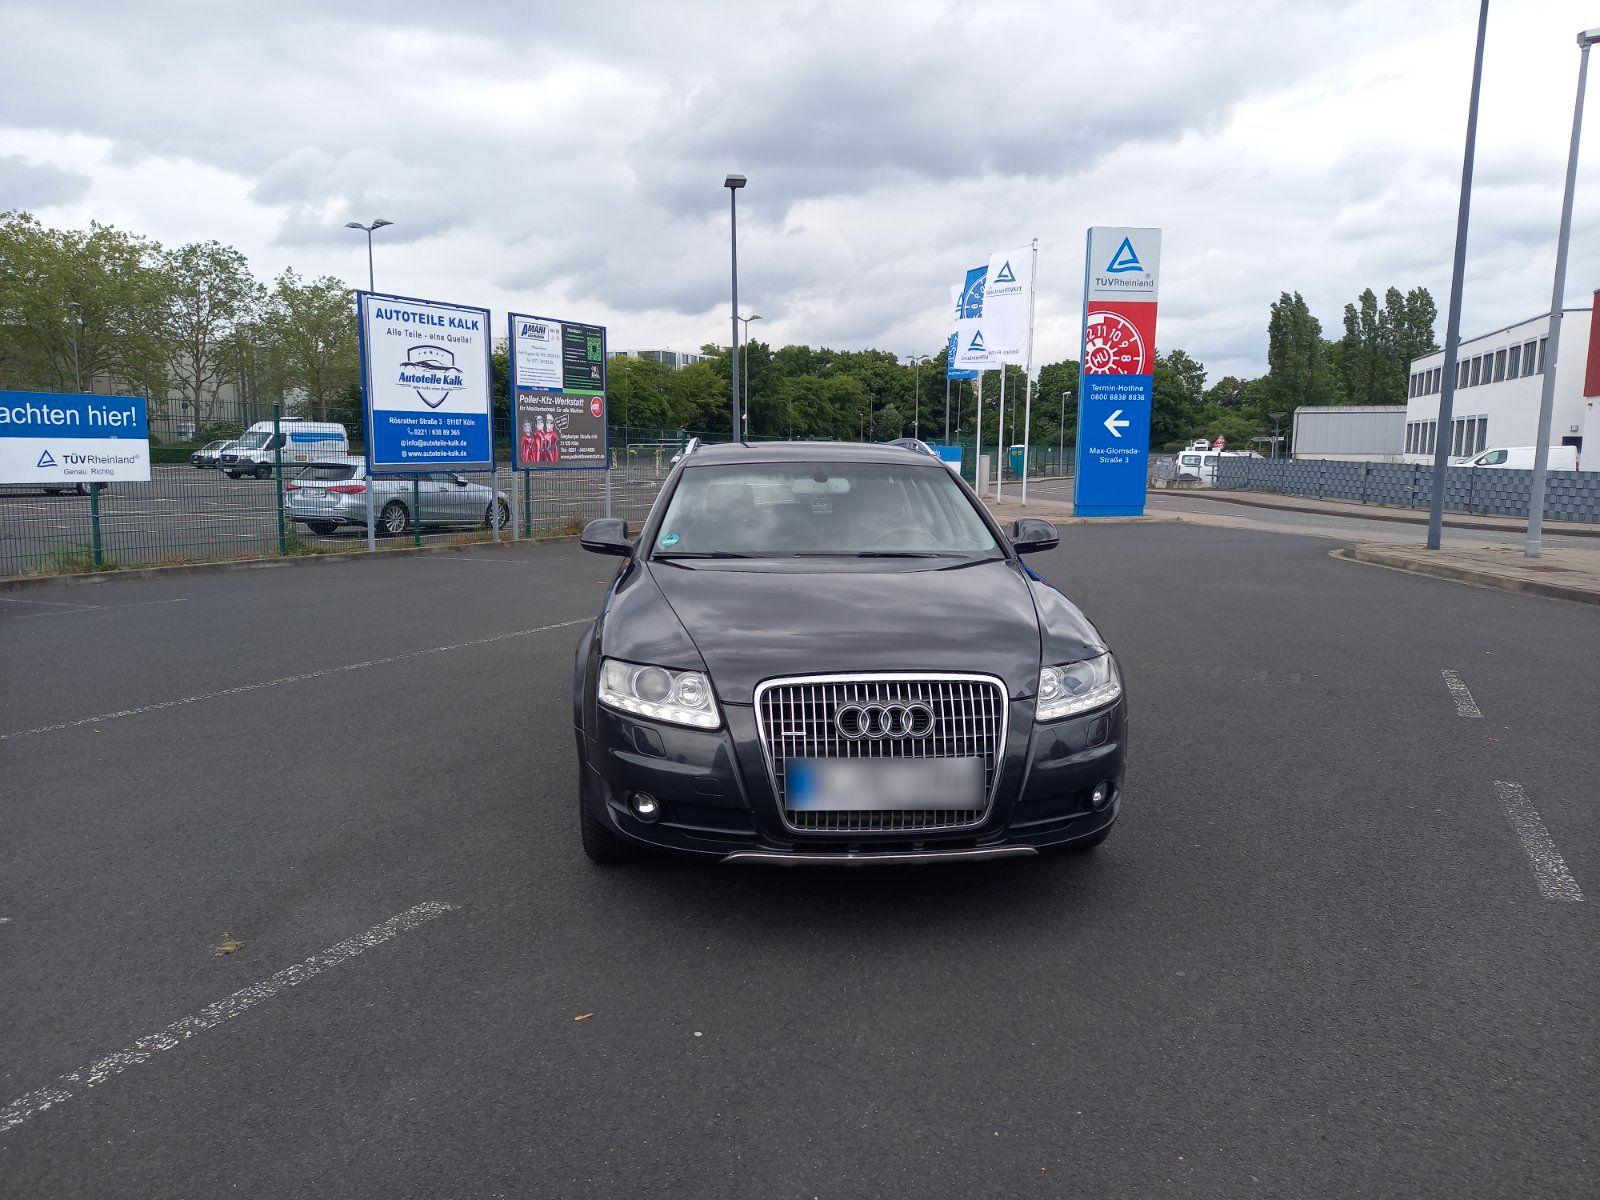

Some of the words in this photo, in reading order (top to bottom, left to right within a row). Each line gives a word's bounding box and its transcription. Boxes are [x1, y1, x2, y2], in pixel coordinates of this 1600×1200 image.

[376, 308, 444, 326] AUTOTEILE
[449, 317, 480, 331] KALK
[386, 328, 401, 336] Alle
[405, 330, 422, 338] Teile
[429, 332, 445, 341] eine
[446, 334, 472, 344] Quelle!
[1097, 325, 1107, 336] 11
[1109, 328, 1122, 342] 10
[1092, 349, 1108, 366] HU
[398, 372, 442, 385] Autoteile
[443, 375, 463, 386] Kalk
[519, 395, 584, 406] Poller-Kfz-Werkstatt
[88, 404, 137, 426] hier!
[389, 416, 418, 425] Rösrather
[406, 439, 467, 447] info@autoteile-kalk.de
[62, 453, 135, 464] TÜVRheinland
